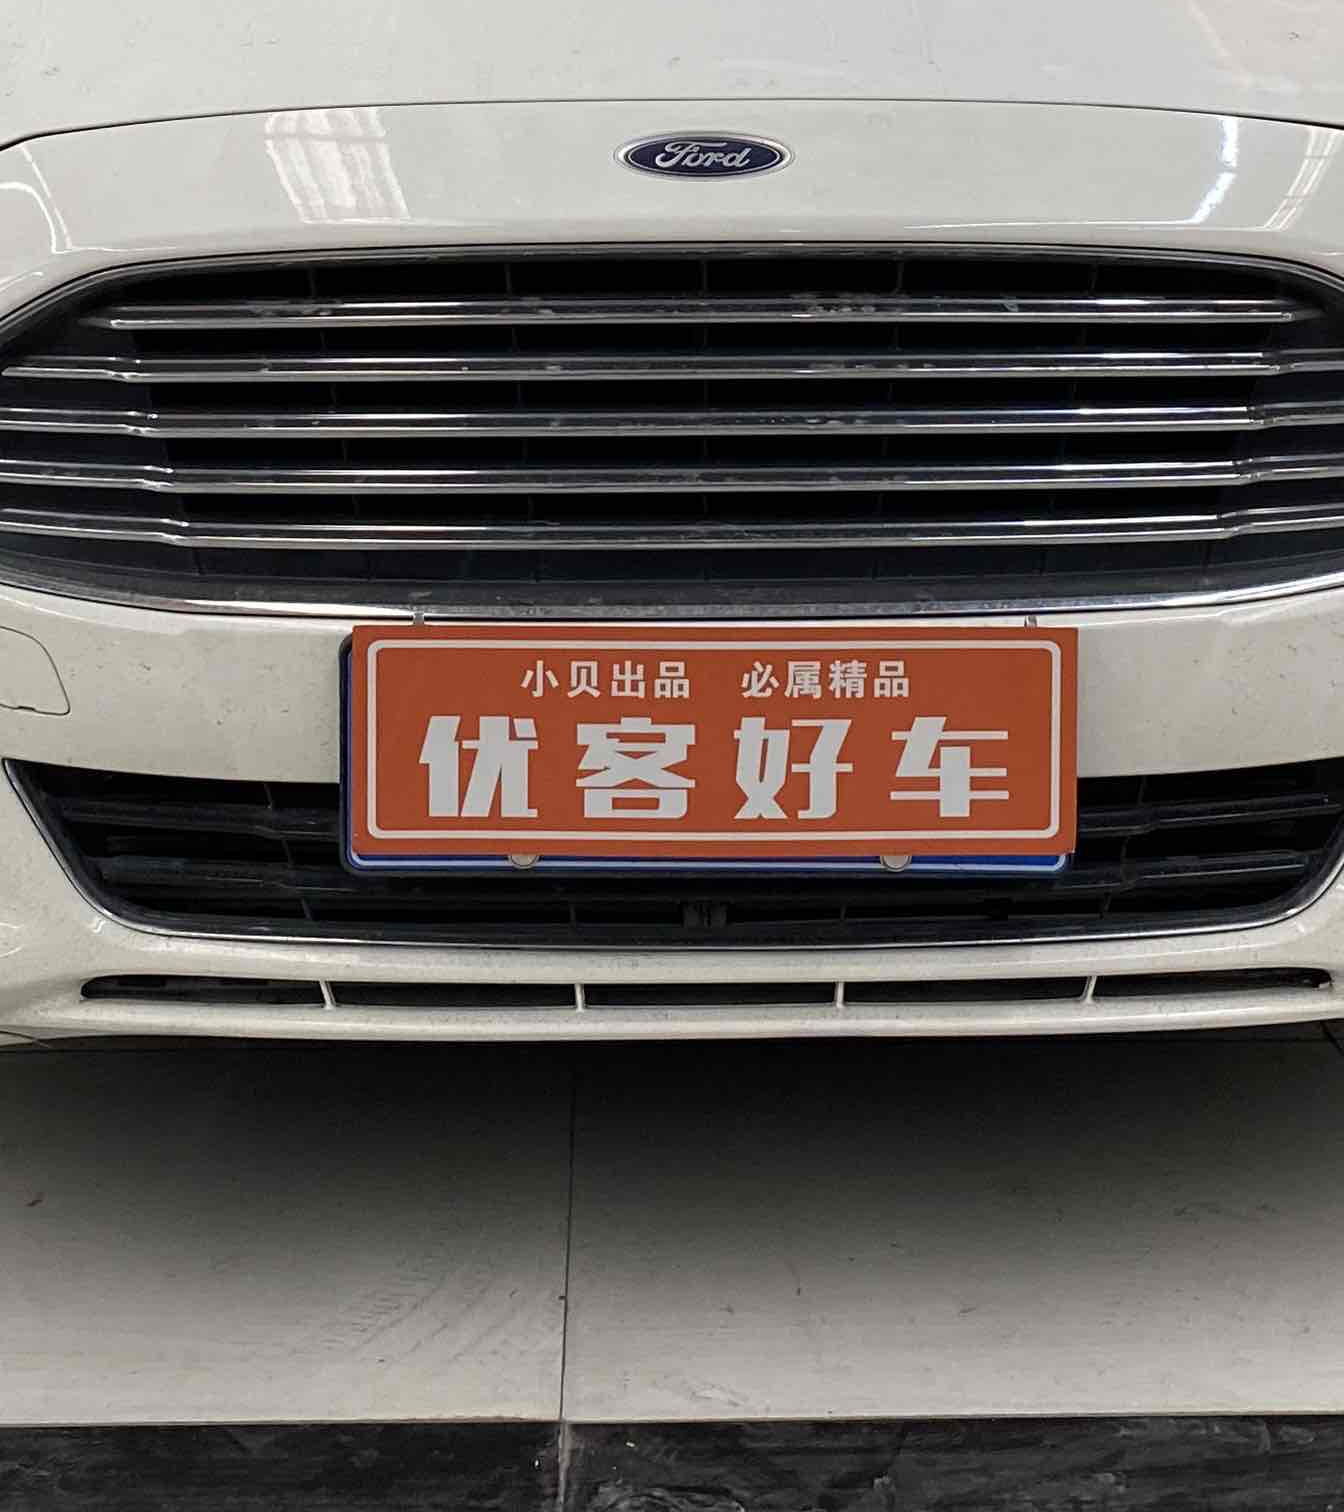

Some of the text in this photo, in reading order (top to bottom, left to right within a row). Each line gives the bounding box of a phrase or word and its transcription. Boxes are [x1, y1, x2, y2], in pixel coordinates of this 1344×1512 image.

[655, 140, 752, 168] Ford
[520, 660, 910, 699] 小贝出品 必属精品
[418, 715, 1011, 820] 优客好车
